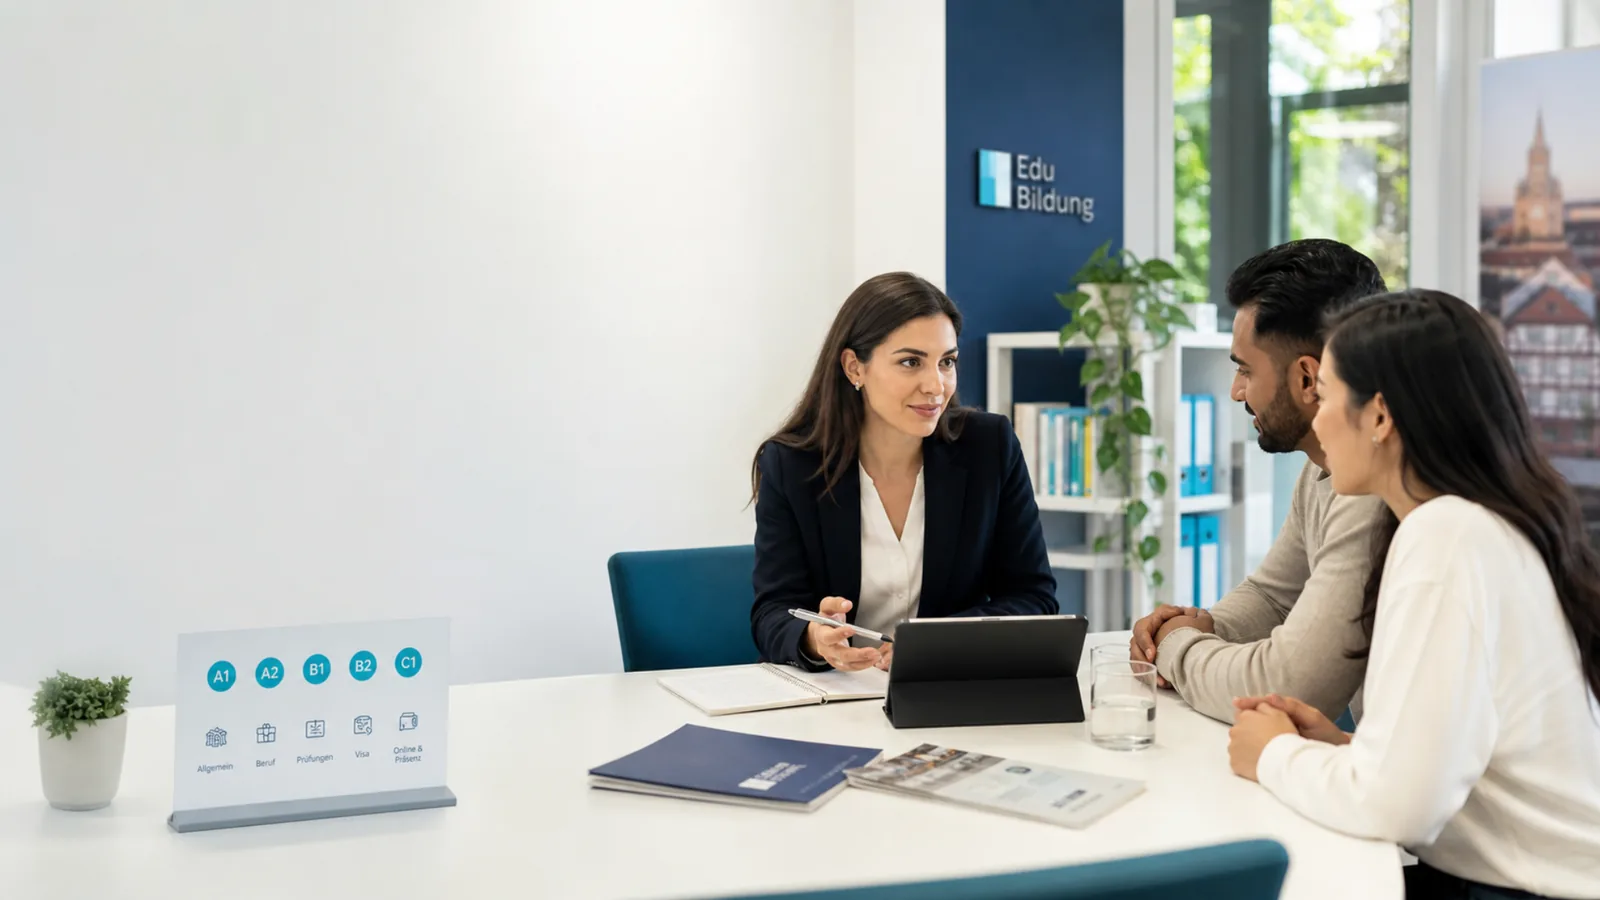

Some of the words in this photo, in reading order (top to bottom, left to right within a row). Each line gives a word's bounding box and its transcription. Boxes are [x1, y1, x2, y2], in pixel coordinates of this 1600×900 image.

[1017, 154, 1055, 182] Edu
[1017, 185, 1094, 223] Bildung
[213, 670, 230, 684] A1
[260, 666, 279, 680] A2
[309, 663, 325, 676] B1
[355, 659, 372, 673] B2
[401, 656, 416, 669] C1
[355, 750, 370, 758] Visa
[393, 745, 416, 754] Online
[256, 758, 276, 768] Beruf
[296, 753, 334, 764] Prüfungen
[197, 762, 234, 774] Allgemein
